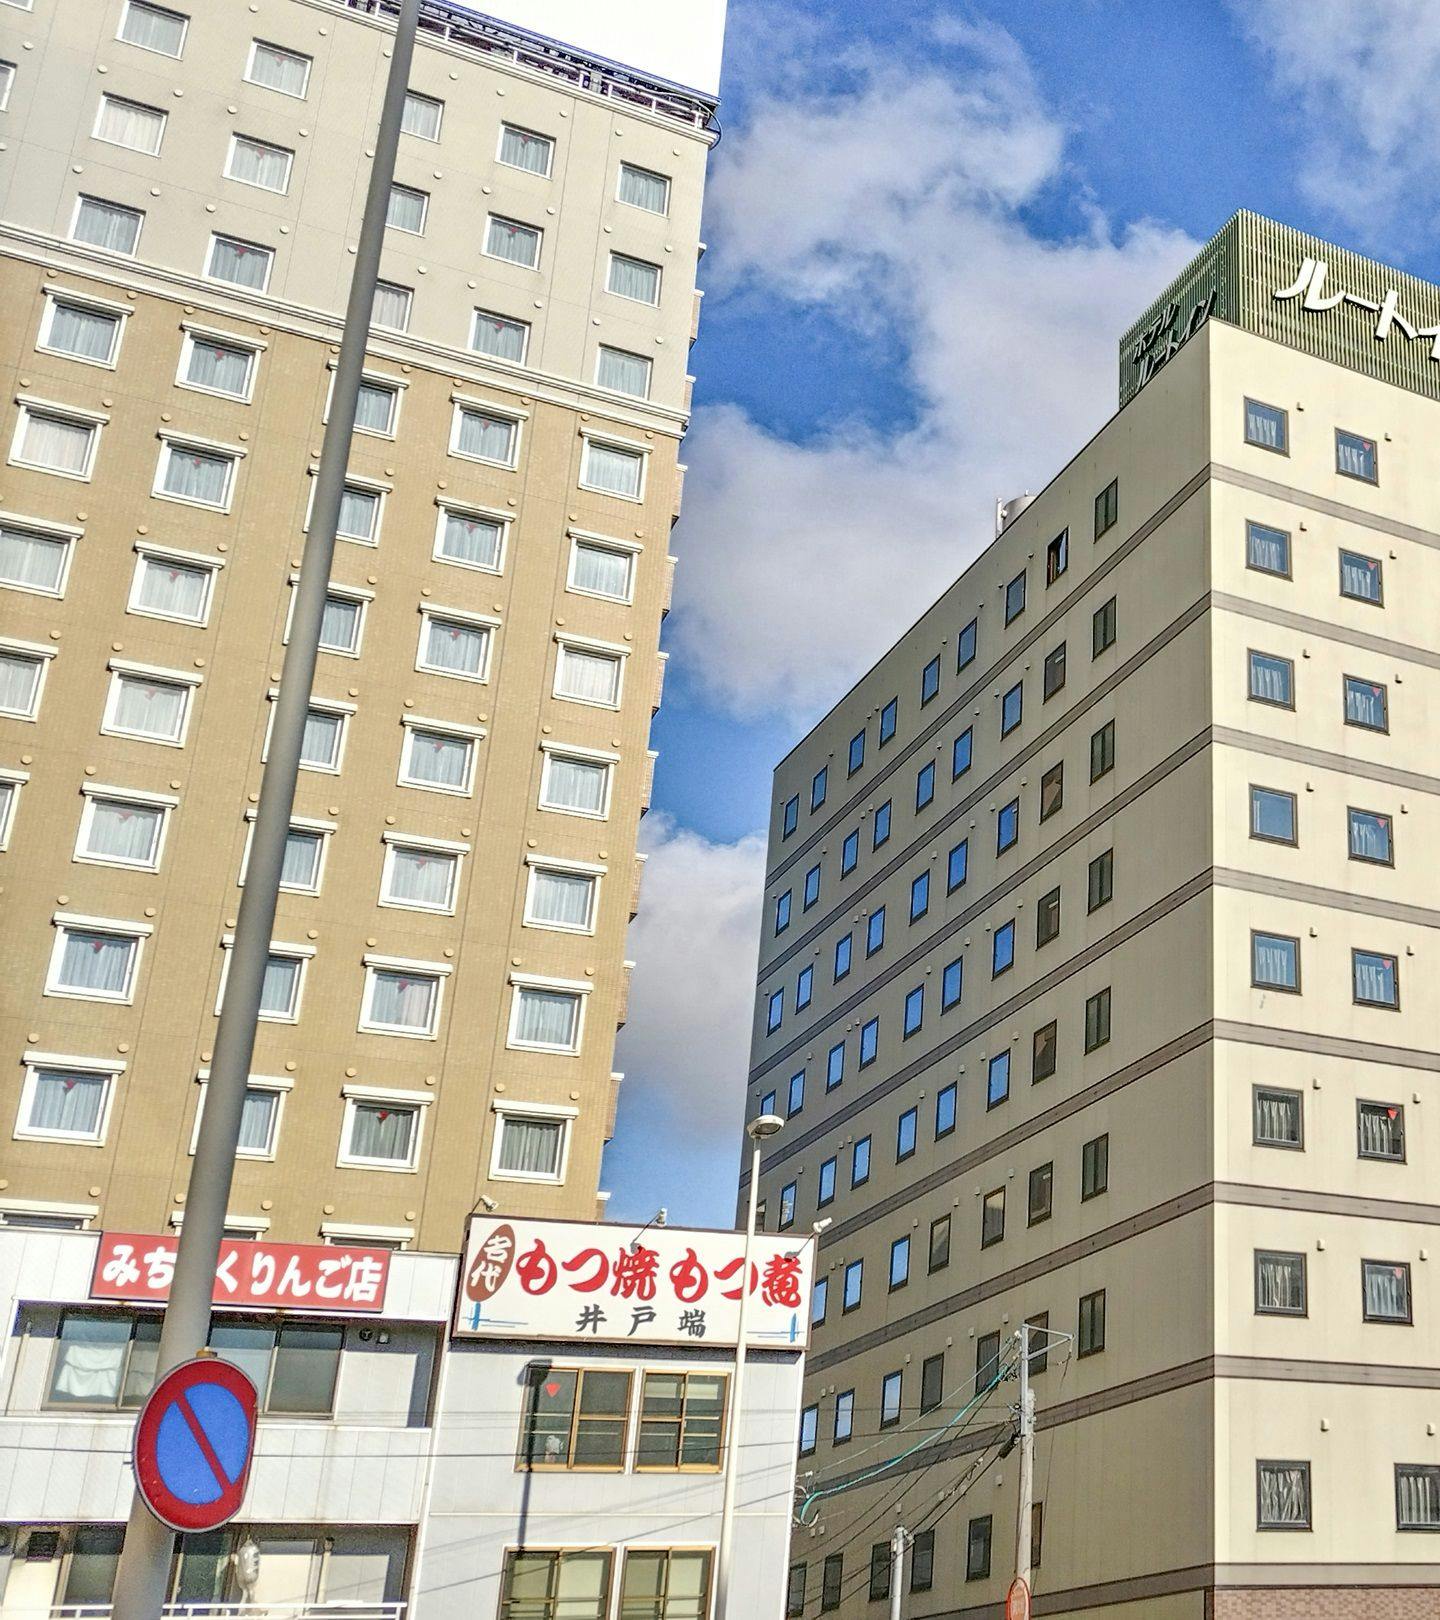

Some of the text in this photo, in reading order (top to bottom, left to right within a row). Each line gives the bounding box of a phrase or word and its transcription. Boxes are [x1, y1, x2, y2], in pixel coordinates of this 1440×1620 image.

[101, 1243, 383, 1302] みちくりんご店
[575, 1303, 707, 1338] 井戸端
